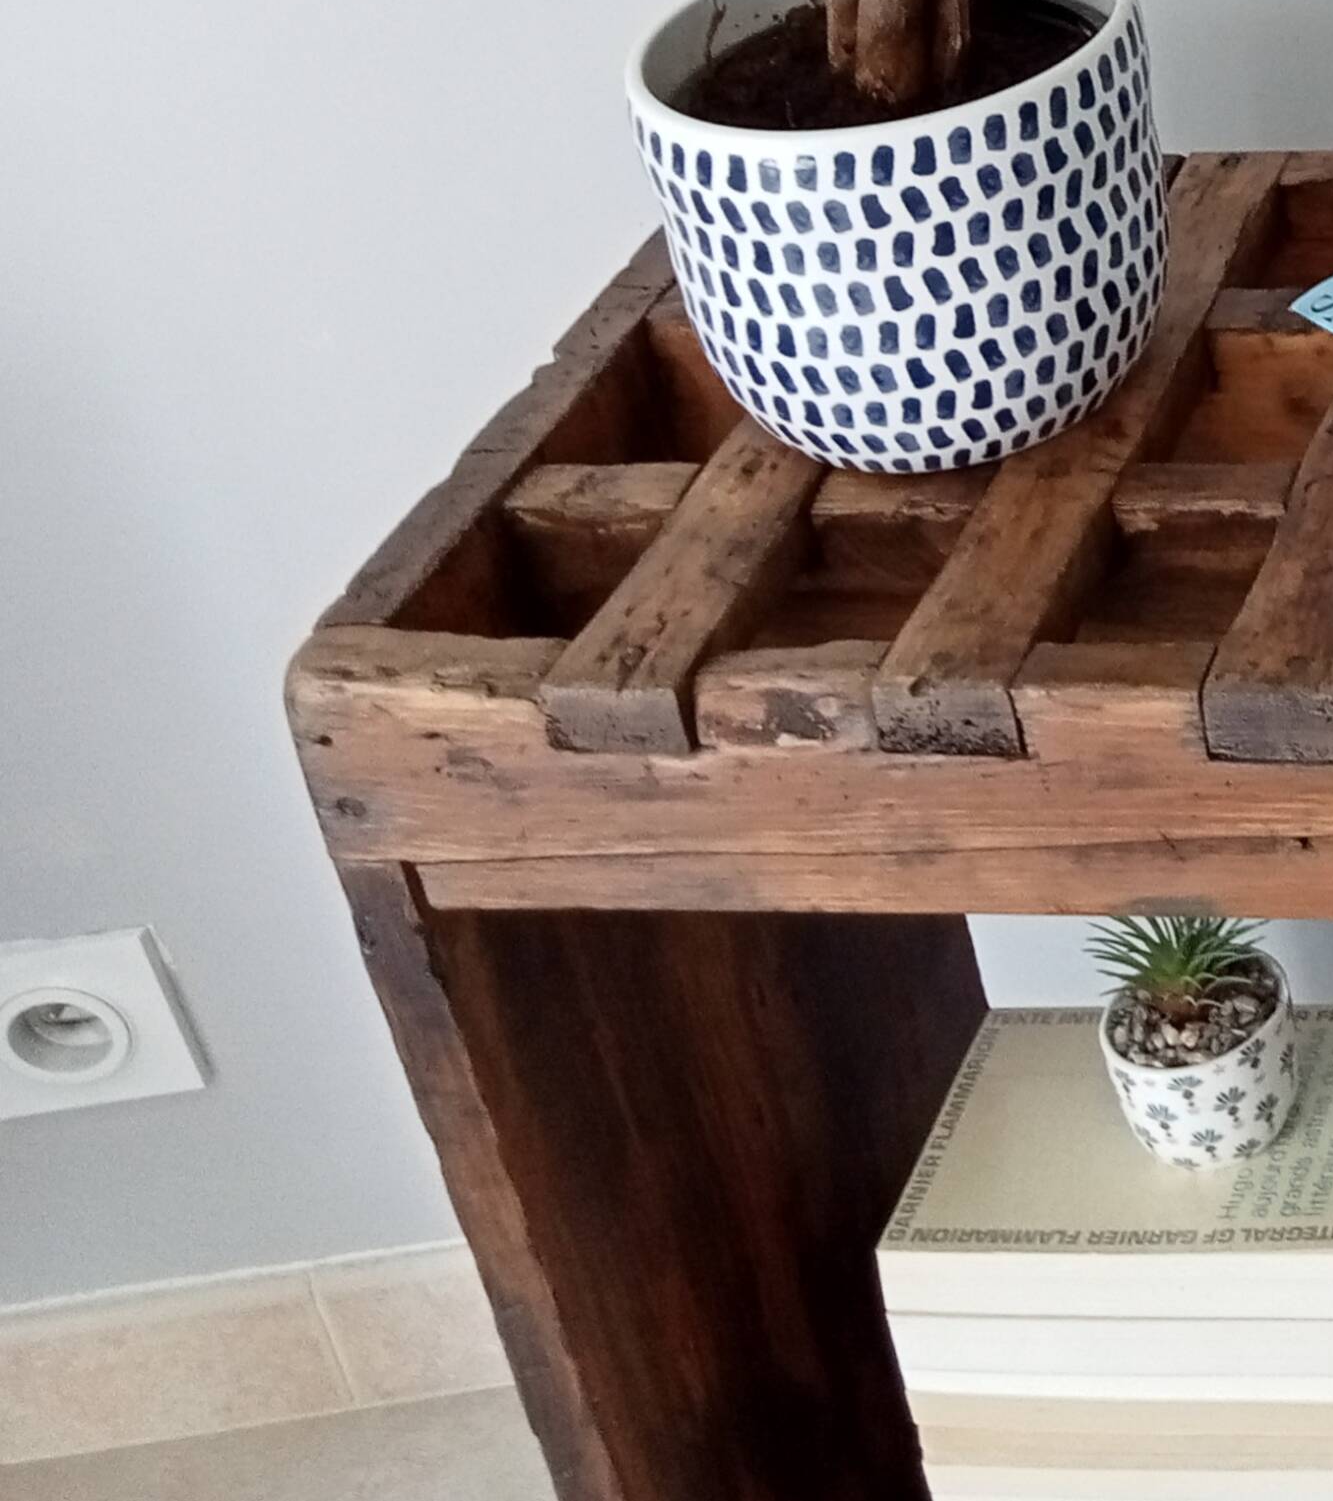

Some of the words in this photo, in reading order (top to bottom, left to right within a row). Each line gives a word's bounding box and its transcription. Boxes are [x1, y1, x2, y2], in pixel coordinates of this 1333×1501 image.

[887, 1154, 941, 1242] GARNIER
[930, 1027, 1000, 1149] FLAMMARION
[1216, 1167, 1254, 1219] Hugo
[1280, 1156, 1313, 1218] grands
[910, 1227, 1080, 1245] FLAMMARION
[1087, 1227, 1198, 1245] GARNIER
[1203, 1227, 1236, 1244] GF
